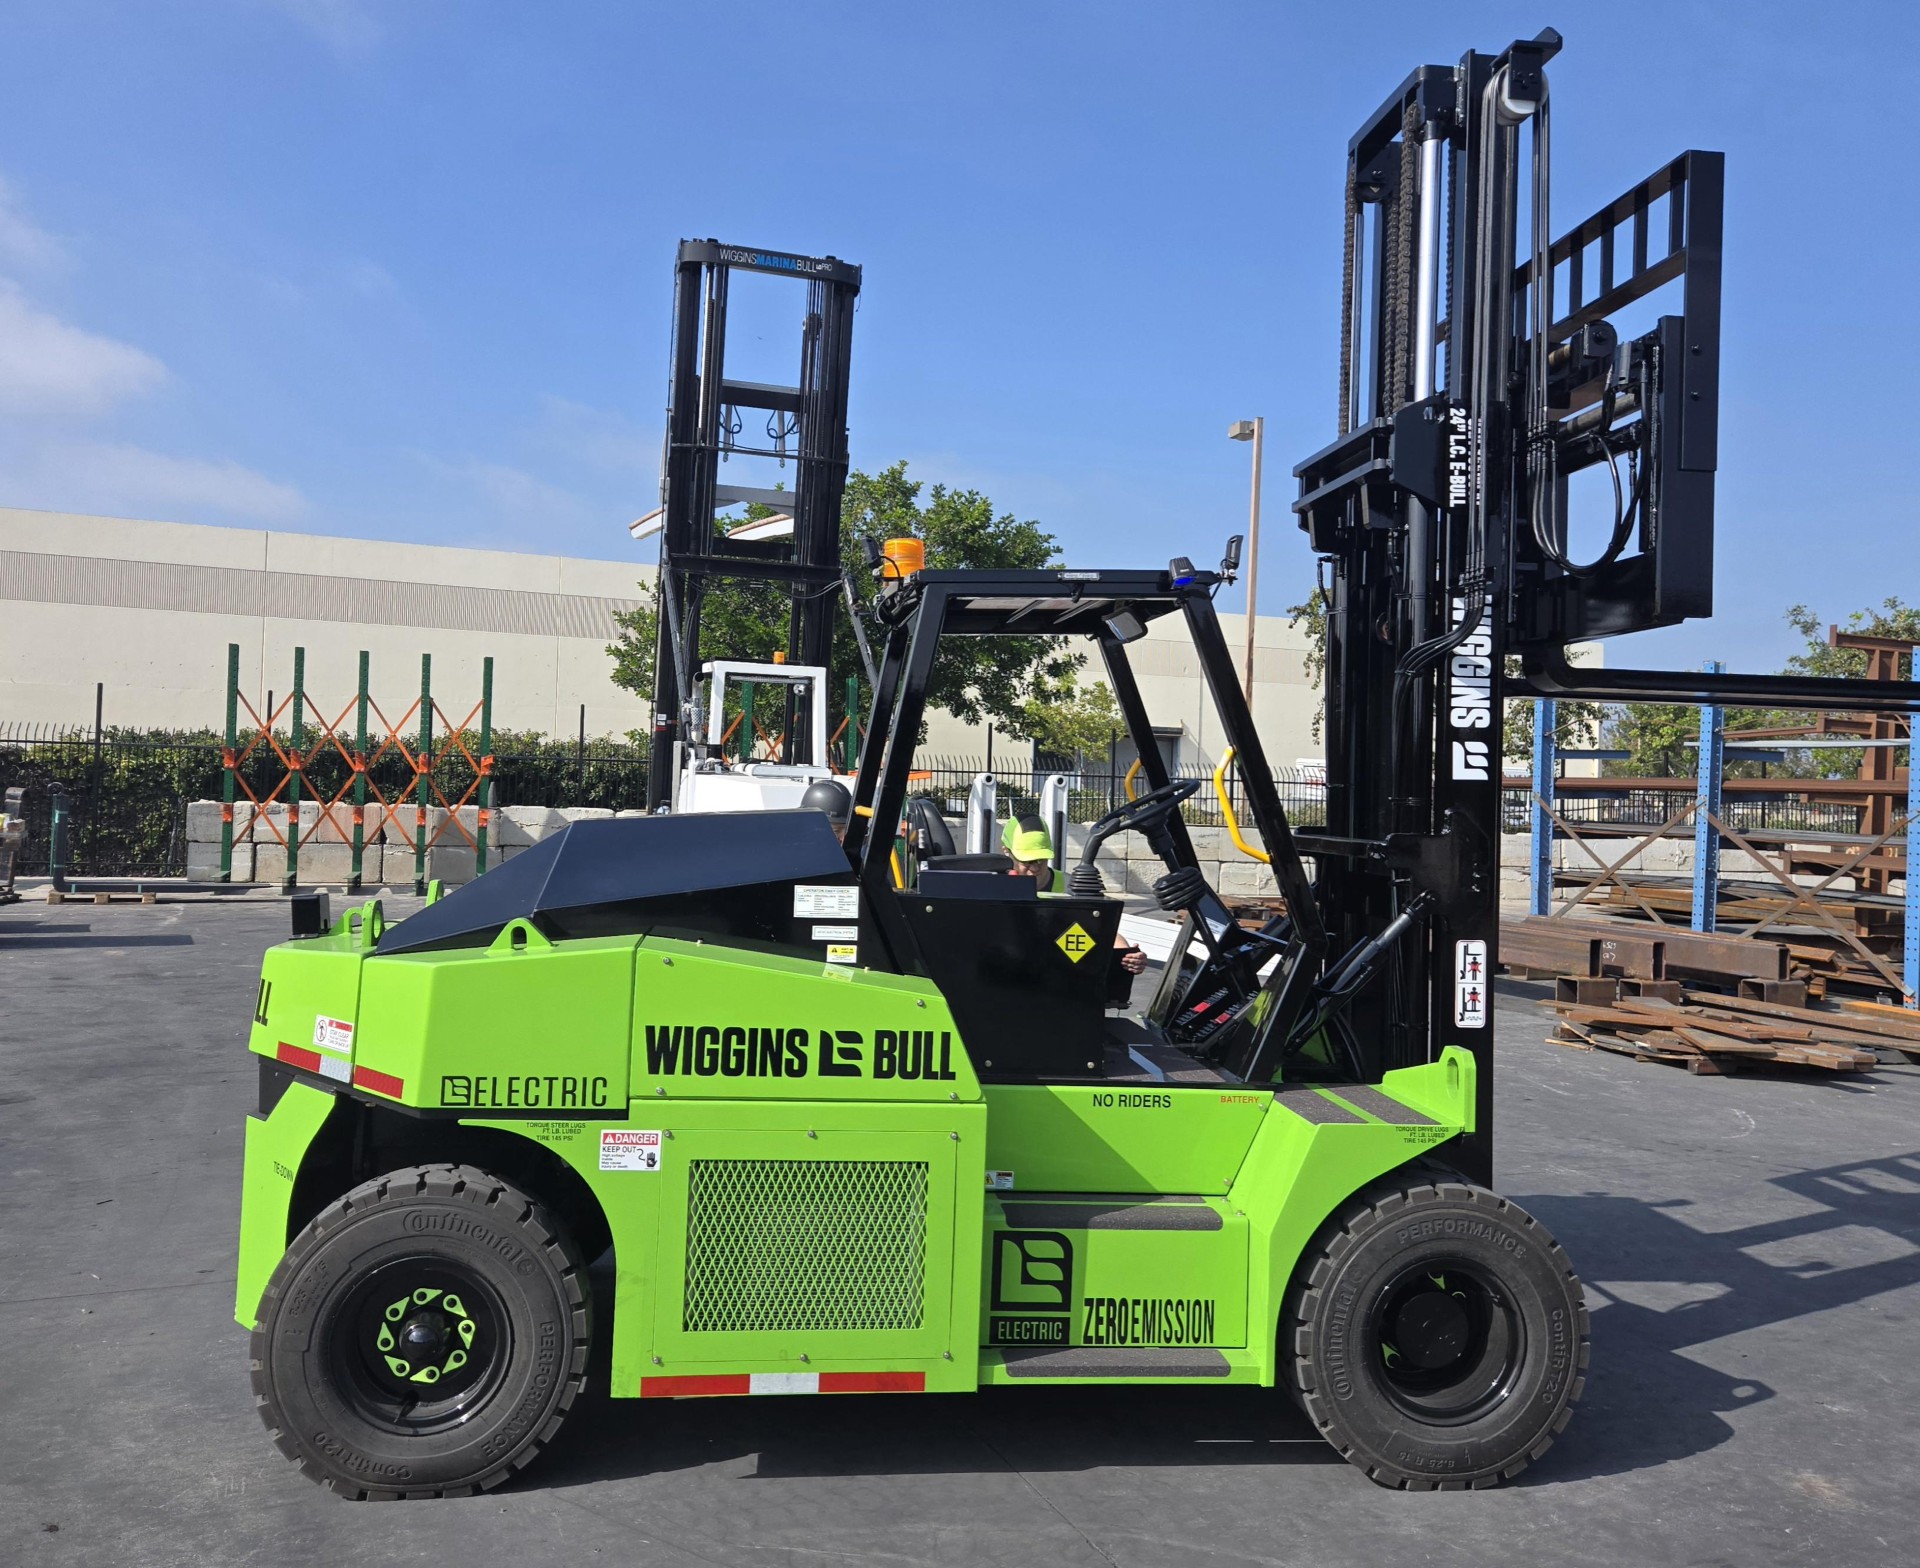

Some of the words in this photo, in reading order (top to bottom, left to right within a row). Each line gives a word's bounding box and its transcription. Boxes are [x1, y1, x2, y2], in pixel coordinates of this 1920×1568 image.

[1449, 435, 1466, 459] L.C.
[1449, 462, 1466, 508] E-BULL
[1065, 934, 1086, 952] EE
[645, 1025, 809, 1078] WIGGINS
[873, 1030, 956, 1080] BULL
[474, 1076, 608, 1107] ELECTRIC
[1092, 1094, 1114, 1107] NO
[1118, 1094, 1171, 1108] RIDERS
[1220, 1095, 1259, 1104] BATTERY
[602, 1145, 621, 1153] KEEP
[615, 1133, 657, 1144] DANGER
[402, 1209, 527, 1269] Continental
[1395, 1218, 1527, 1259] PERFORMANCE
[998, 1320, 1063, 1340] ELECTRIC
[1326, 1279, 1361, 1401] Continental
[483, 1320, 555, 1458] PERFORMANCE
